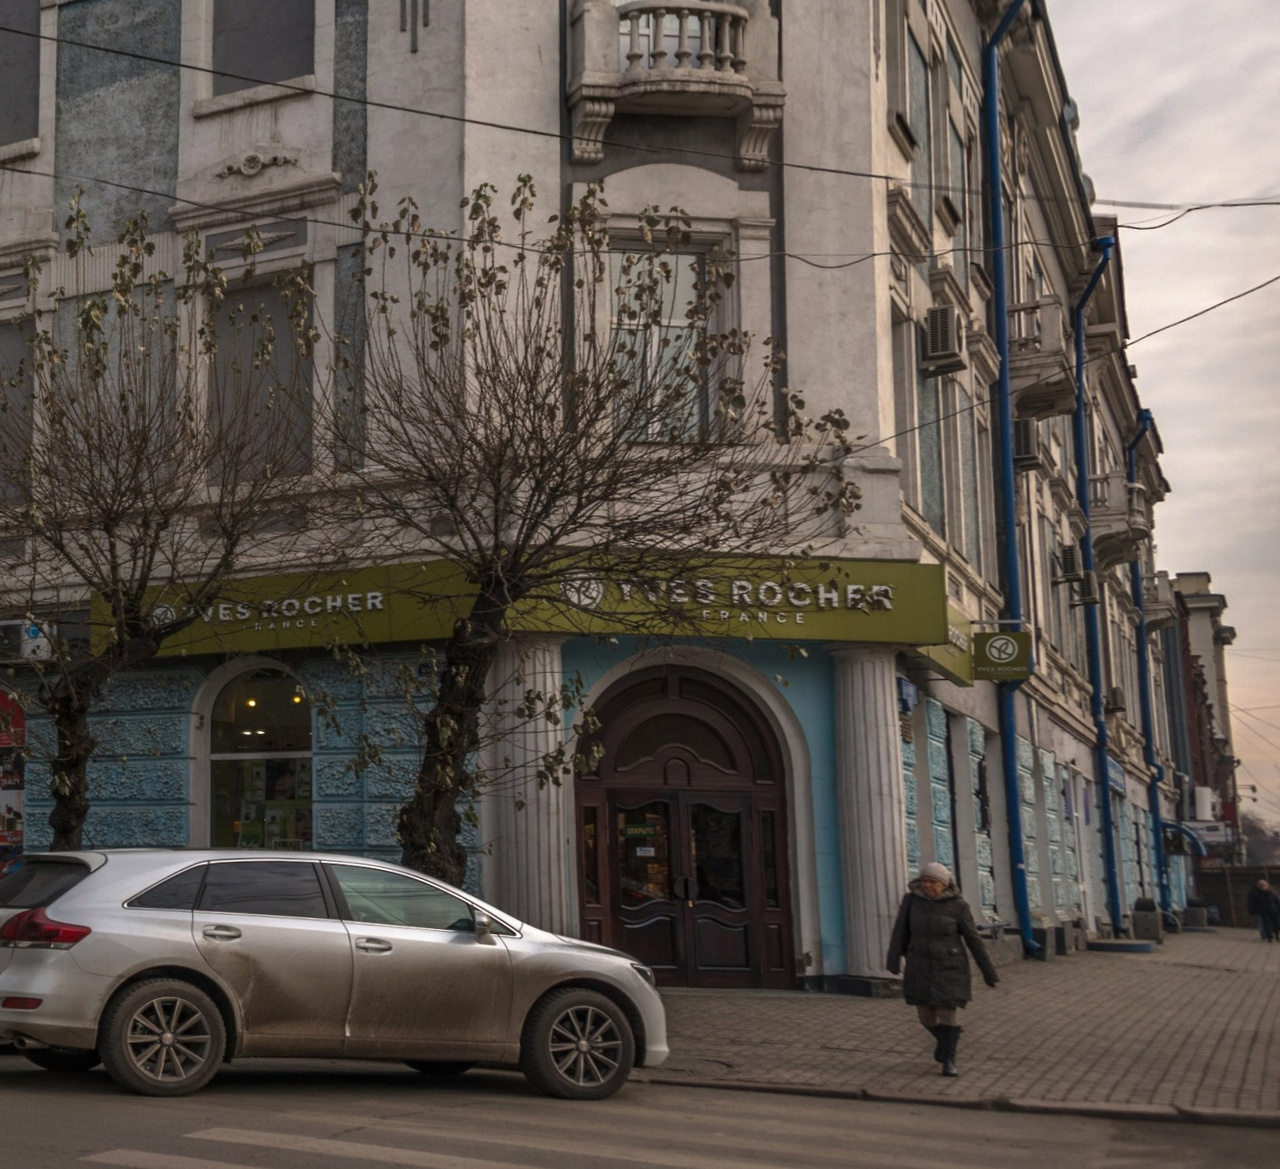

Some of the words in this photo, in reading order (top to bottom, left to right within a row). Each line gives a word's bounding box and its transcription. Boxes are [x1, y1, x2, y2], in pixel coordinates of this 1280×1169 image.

[731, 580, 894, 611] ROCHER
[182, 603, 251, 622] VES
[261, 592, 384, 618] ROCHER
[702, 610, 805, 624] FRANCE
[1, 778, 20, 786] ЗАЛ
